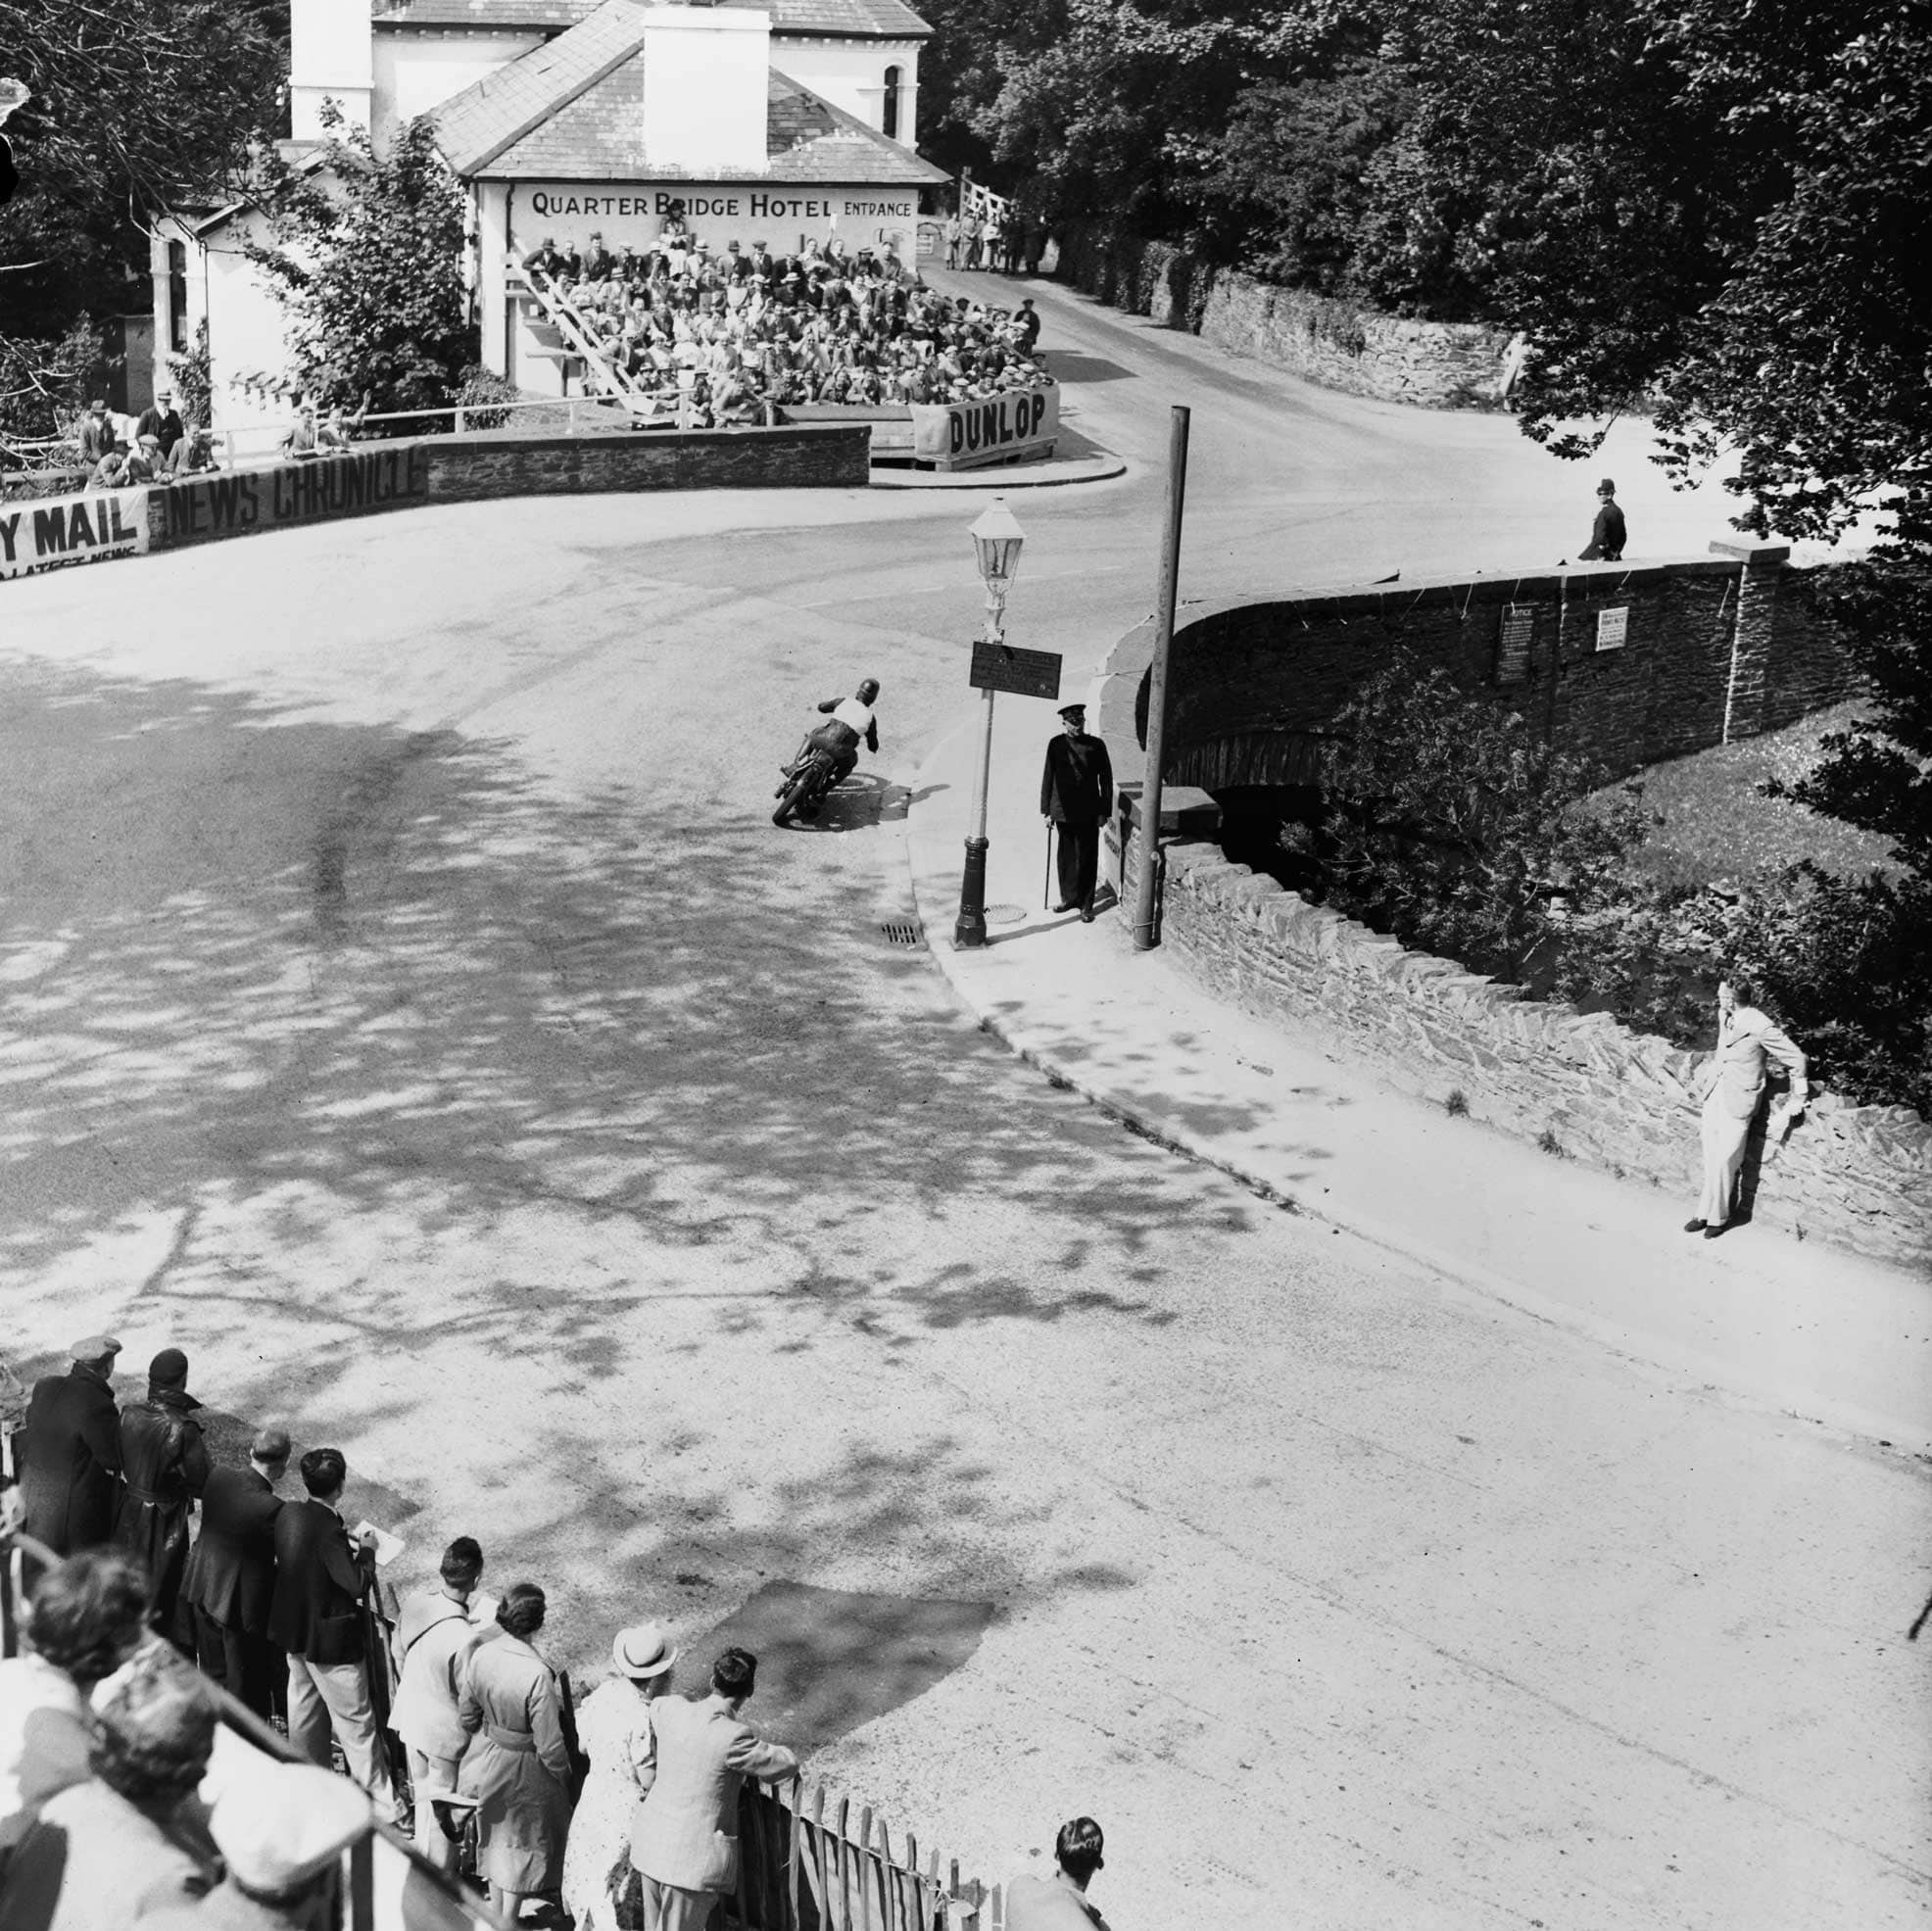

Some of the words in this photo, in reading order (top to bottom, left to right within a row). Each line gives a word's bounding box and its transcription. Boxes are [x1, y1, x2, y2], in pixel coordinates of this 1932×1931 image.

[532, 192, 649, 218] QUARTER
[654, 192, 740, 217] BRIDGE
[749, 194, 831, 217] HOTEL
[844, 201, 912, 217] ENTRANCE
[948, 394, 1045, 454] DUNLOP
[168, 472, 259, 536] NEWS
[273, 445, 427, 520] CHRONICLE
[33, 497, 137, 556] MAIL
